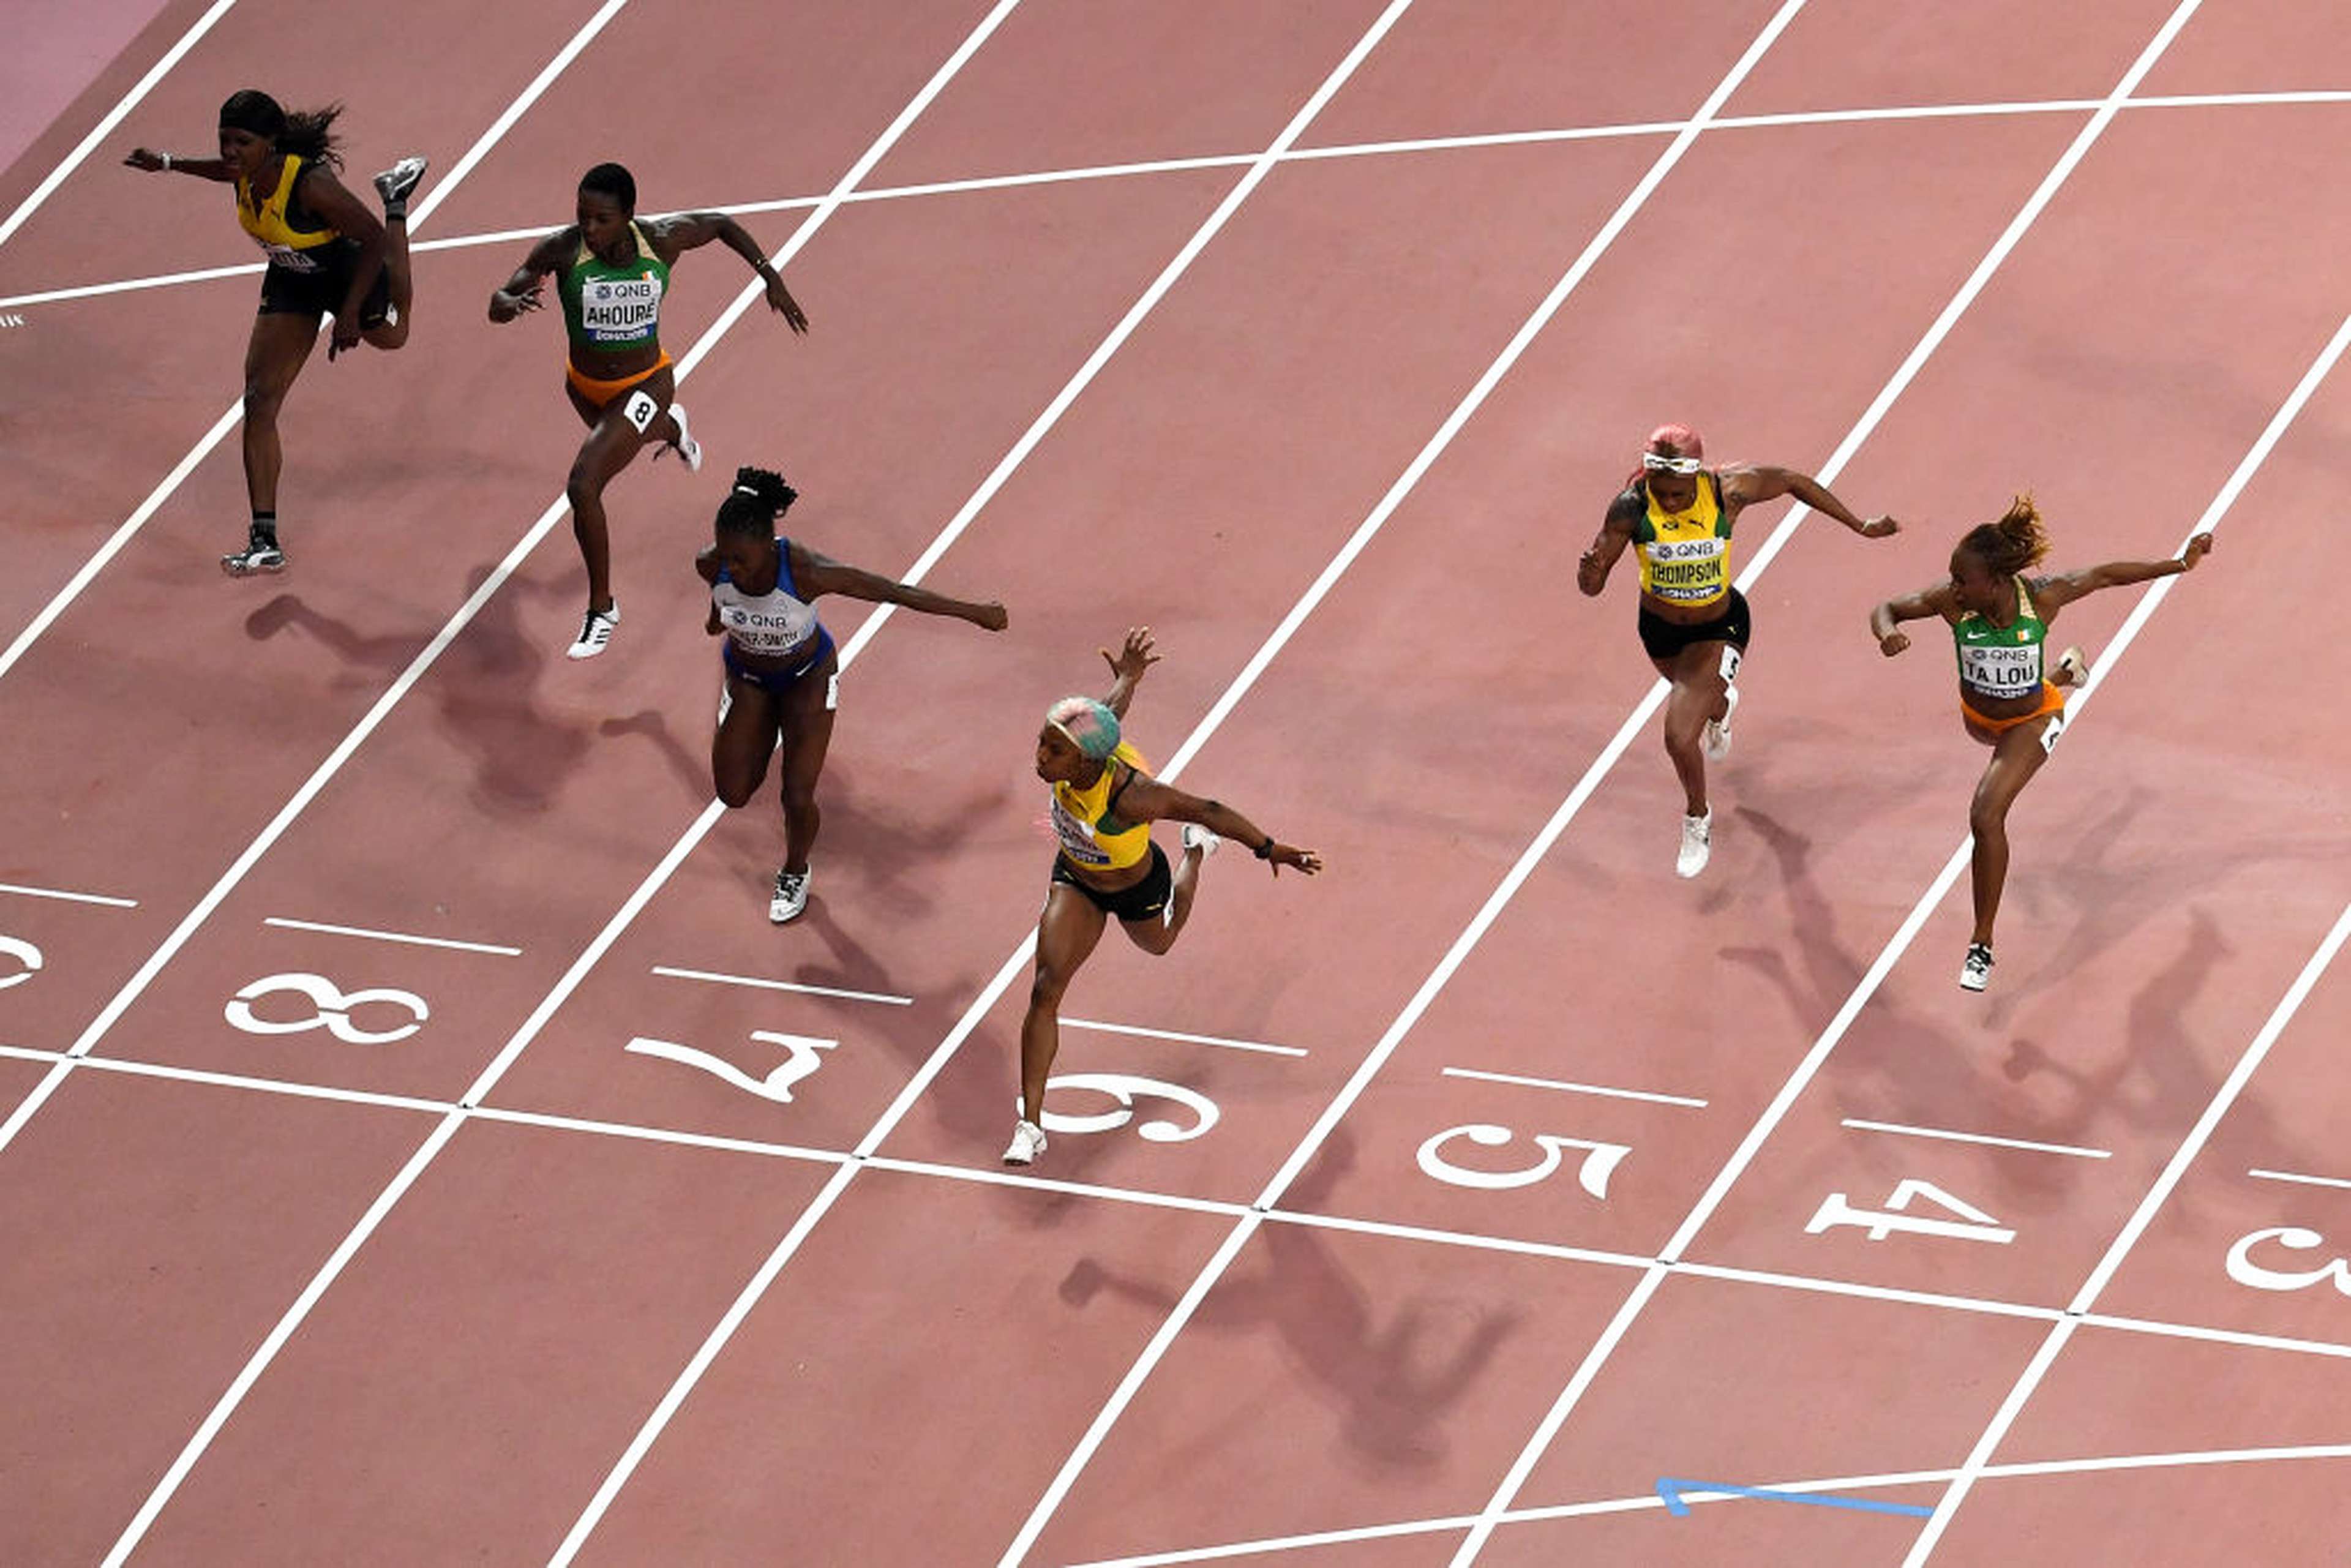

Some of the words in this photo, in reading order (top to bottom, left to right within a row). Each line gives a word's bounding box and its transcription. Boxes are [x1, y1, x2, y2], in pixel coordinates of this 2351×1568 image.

[615, 284, 651, 298] QNB
[587, 298, 655, 326] AHOURÉ
[635, 401, 650, 423] 8
[1677, 541, 1714, 557] QNB
[1652, 558, 1721, 583] THOMPSON
[1990, 649, 2028, 662] QNB
[1965, 661, 1989, 683] TA
[1997, 664, 2034, 685] LOU
[224, 972, 430, 1045] 8
[624, 1030, 839, 1103] 7
[1016, 1072, 1221, 1142] 6
[1415, 1123, 1633, 1200] 5
[1804, 1178, 2018, 1243] 4
